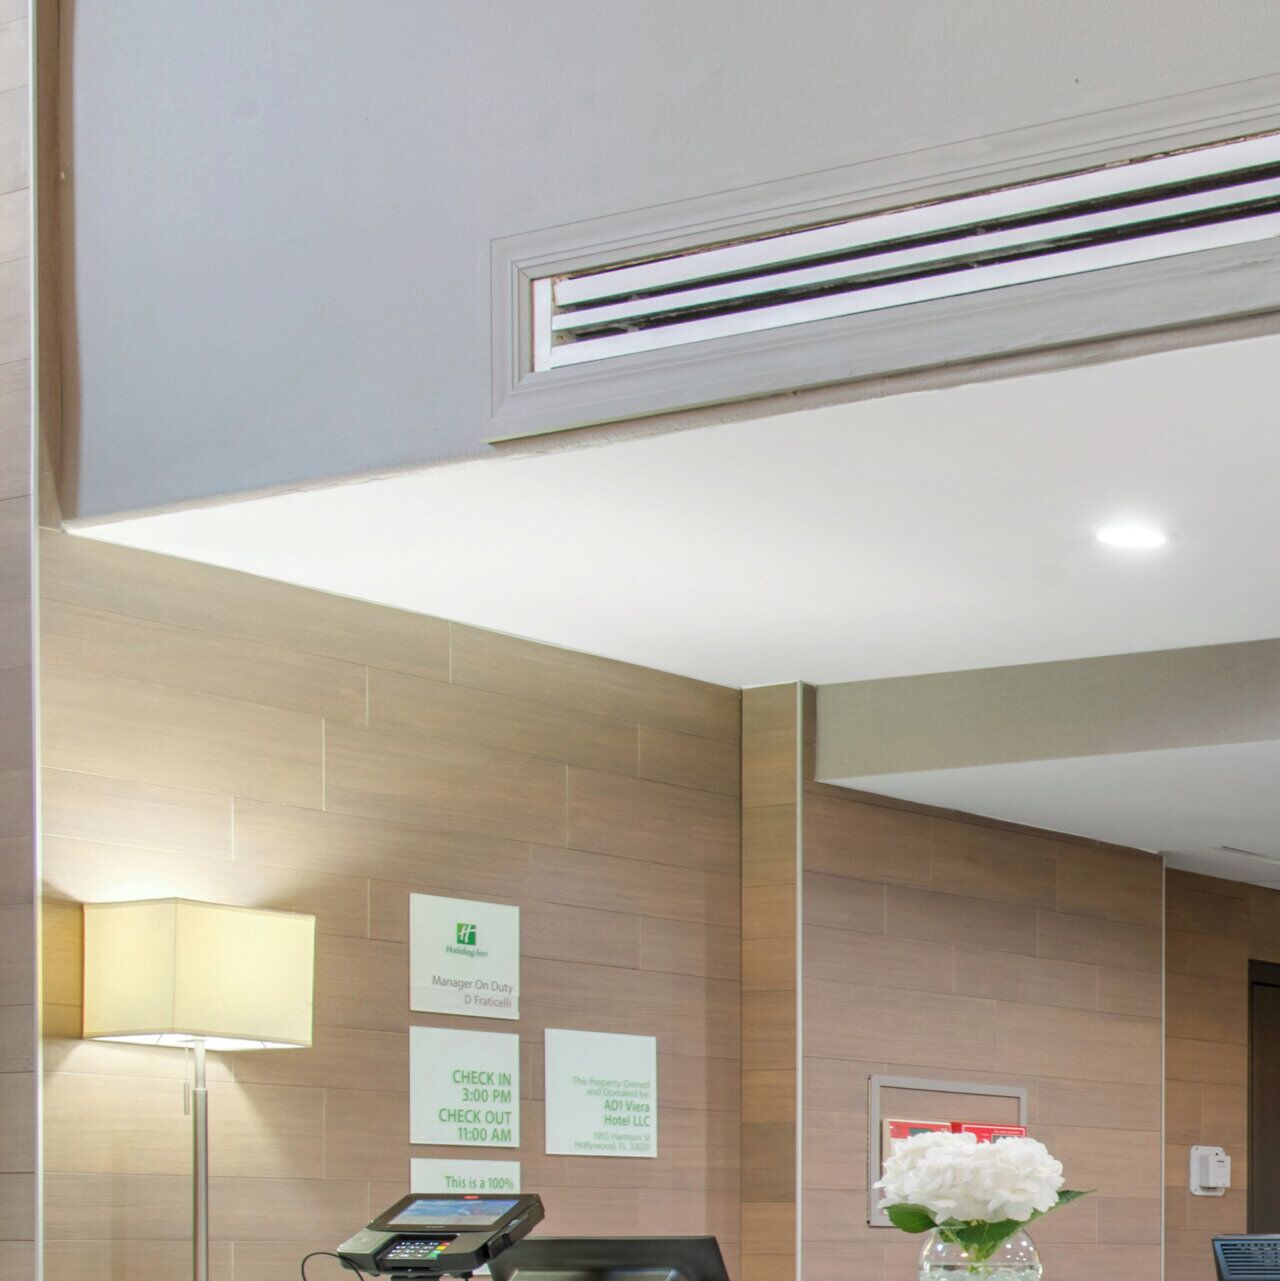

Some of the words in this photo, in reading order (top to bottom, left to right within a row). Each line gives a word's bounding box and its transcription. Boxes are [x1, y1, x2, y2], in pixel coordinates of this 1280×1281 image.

[445, 945, 475, 957] Holiday
[432, 975, 473, 991] Manager
[475, 979, 489, 990] On
[491, 980, 513, 995] Duty
[464, 994, 472, 1004] D
[452, 1069, 495, 1086] CHECK
[498, 1072, 512, 1086] IN
[462, 1088, 489, 1102] 3:00
[493, 1089, 512, 1103] PM
[625, 1100, 650, 1113] Viera
[438, 1108, 481, 1124] CHECK
[485, 1110, 512, 1125] OUT
[604, 1114, 631, 1127] Hotel
[633, 1115, 651, 1127] LLC
[458, 1127, 488, 1141] 11:00
[491, 1128, 512, 1142] AM
[445, 1175, 466, 1189] This
[469, 1176, 478, 1189] is
[480, 1180, 486, 1189] a
[488, 1178, 514, 1190] 100%
